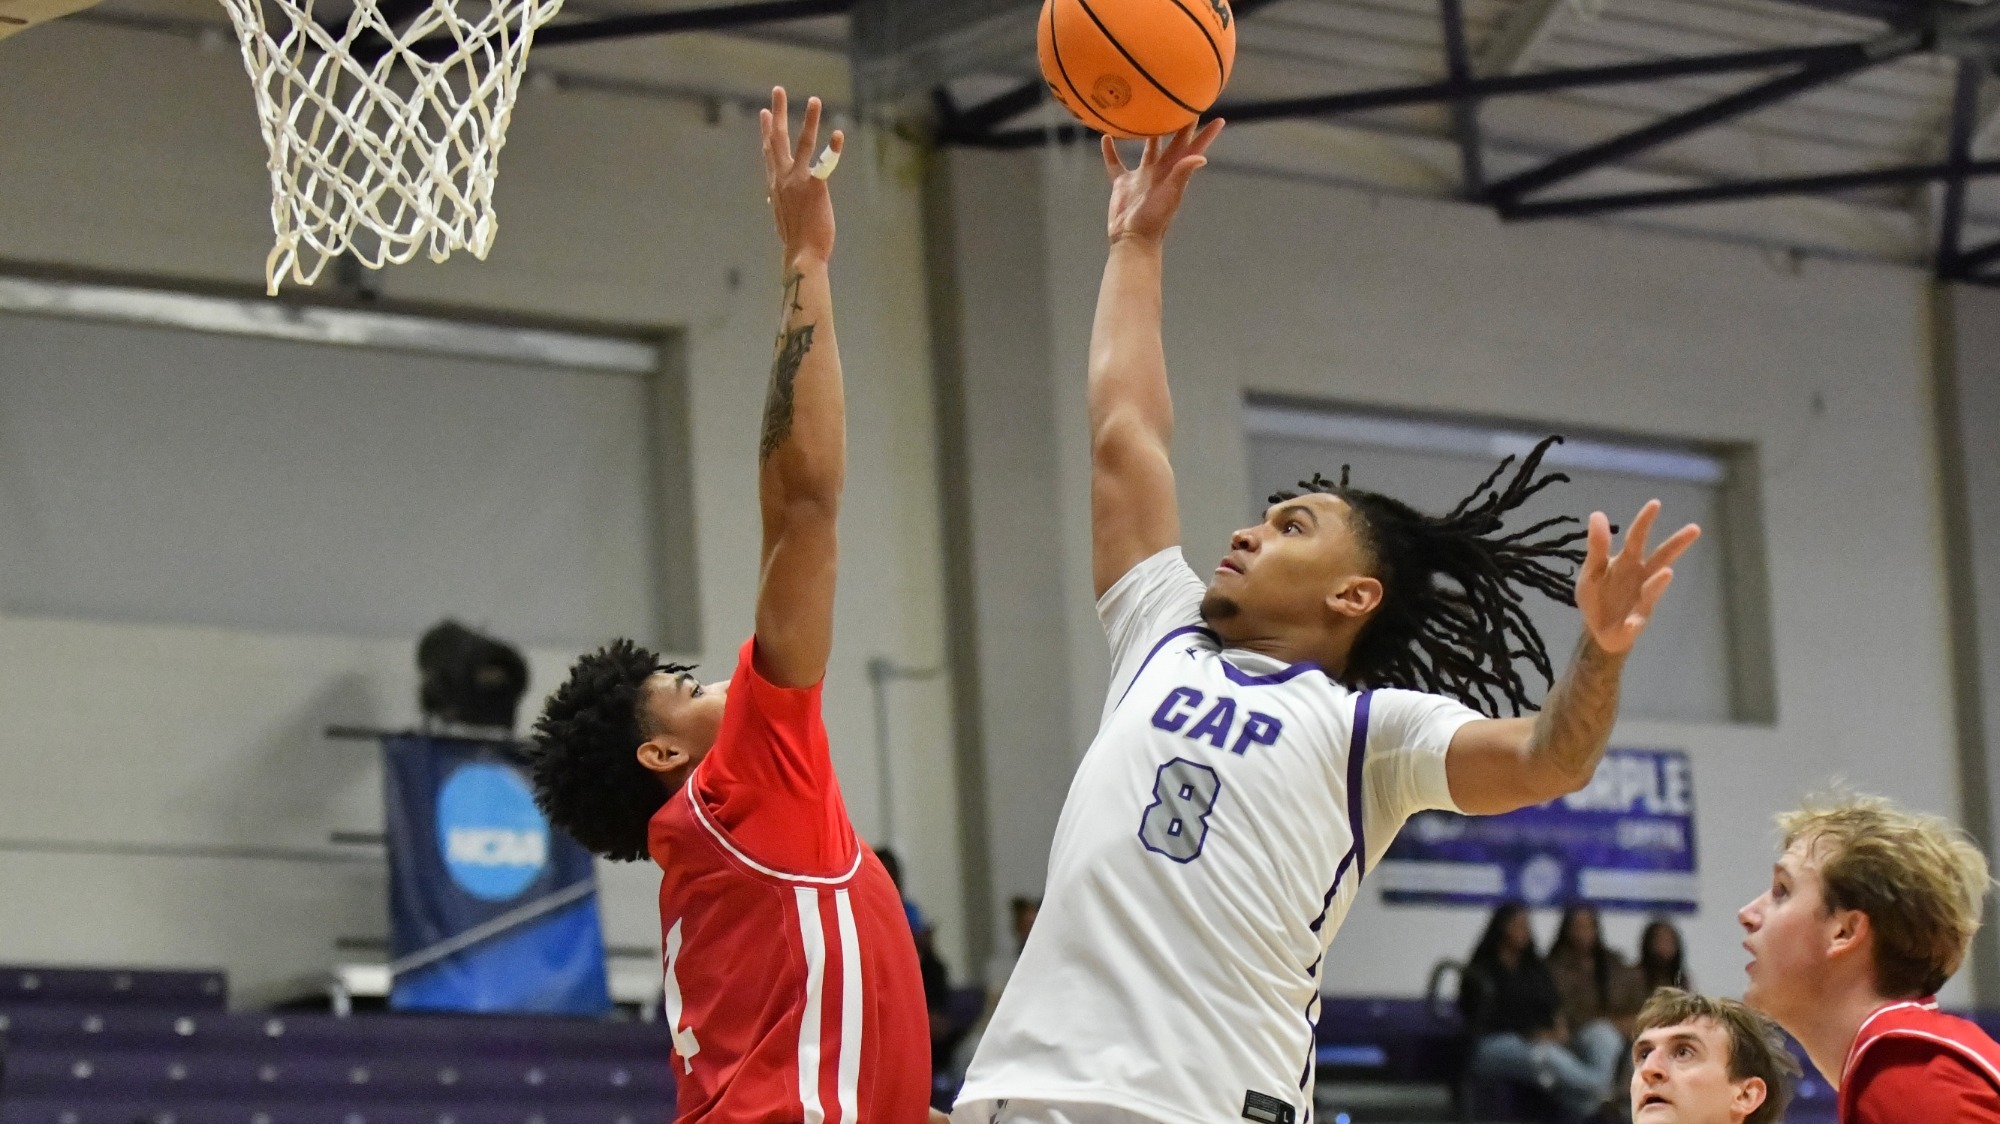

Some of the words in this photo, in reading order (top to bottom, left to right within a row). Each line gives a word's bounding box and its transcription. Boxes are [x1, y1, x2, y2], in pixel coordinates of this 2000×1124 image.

[1151, 686, 1283, 756] CAP
[1138, 756, 1221, 865] 8
[1283, 1111, 1289, 1123] L
